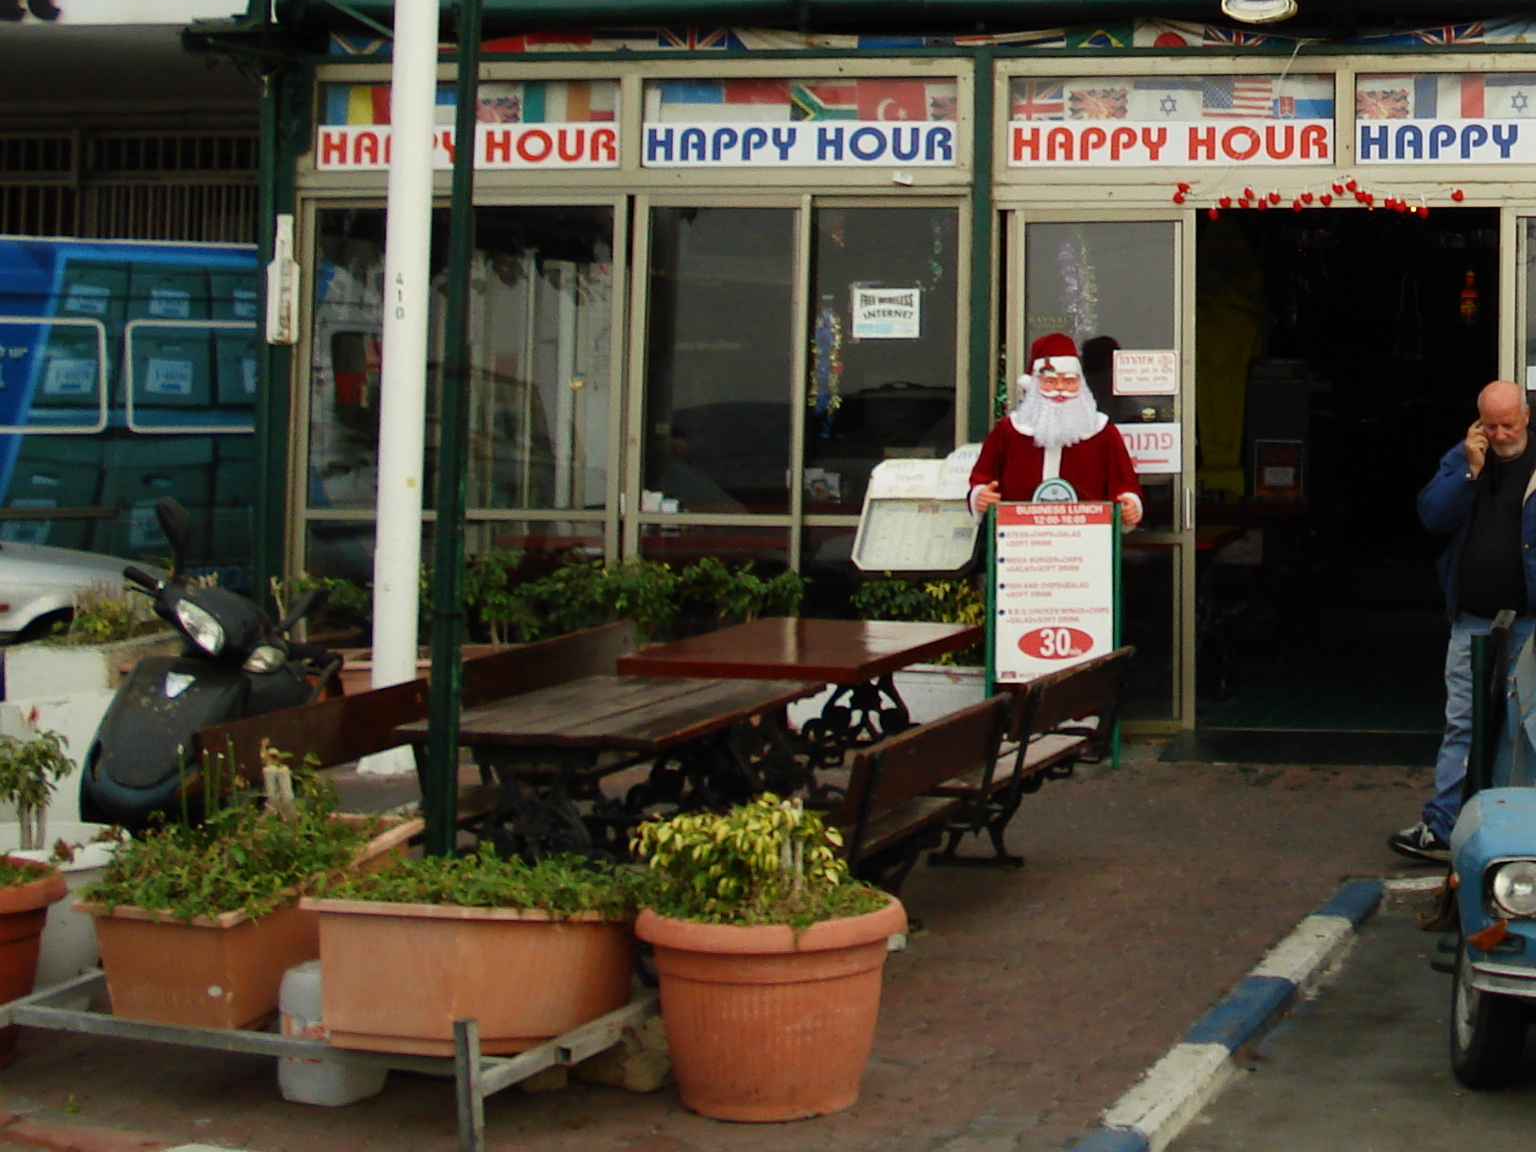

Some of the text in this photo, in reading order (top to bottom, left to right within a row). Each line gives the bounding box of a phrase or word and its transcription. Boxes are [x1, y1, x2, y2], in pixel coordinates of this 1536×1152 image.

[485, 128, 616, 162] HOUR
[647, 126, 952, 161] HAPPY HOUR
[1013, 125, 1328, 161] HAPPY HOUR
[1360, 124, 1518, 159] HAPPY
[396, 273, 405, 320] 410
[860, 293, 914, 308] FREE WIRELESS
[863, 309, 914, 320] INTERNET
[1015, 504, 1103, 515] BUSINESS LUNCH
[1040, 628, 1072, 657] 30
